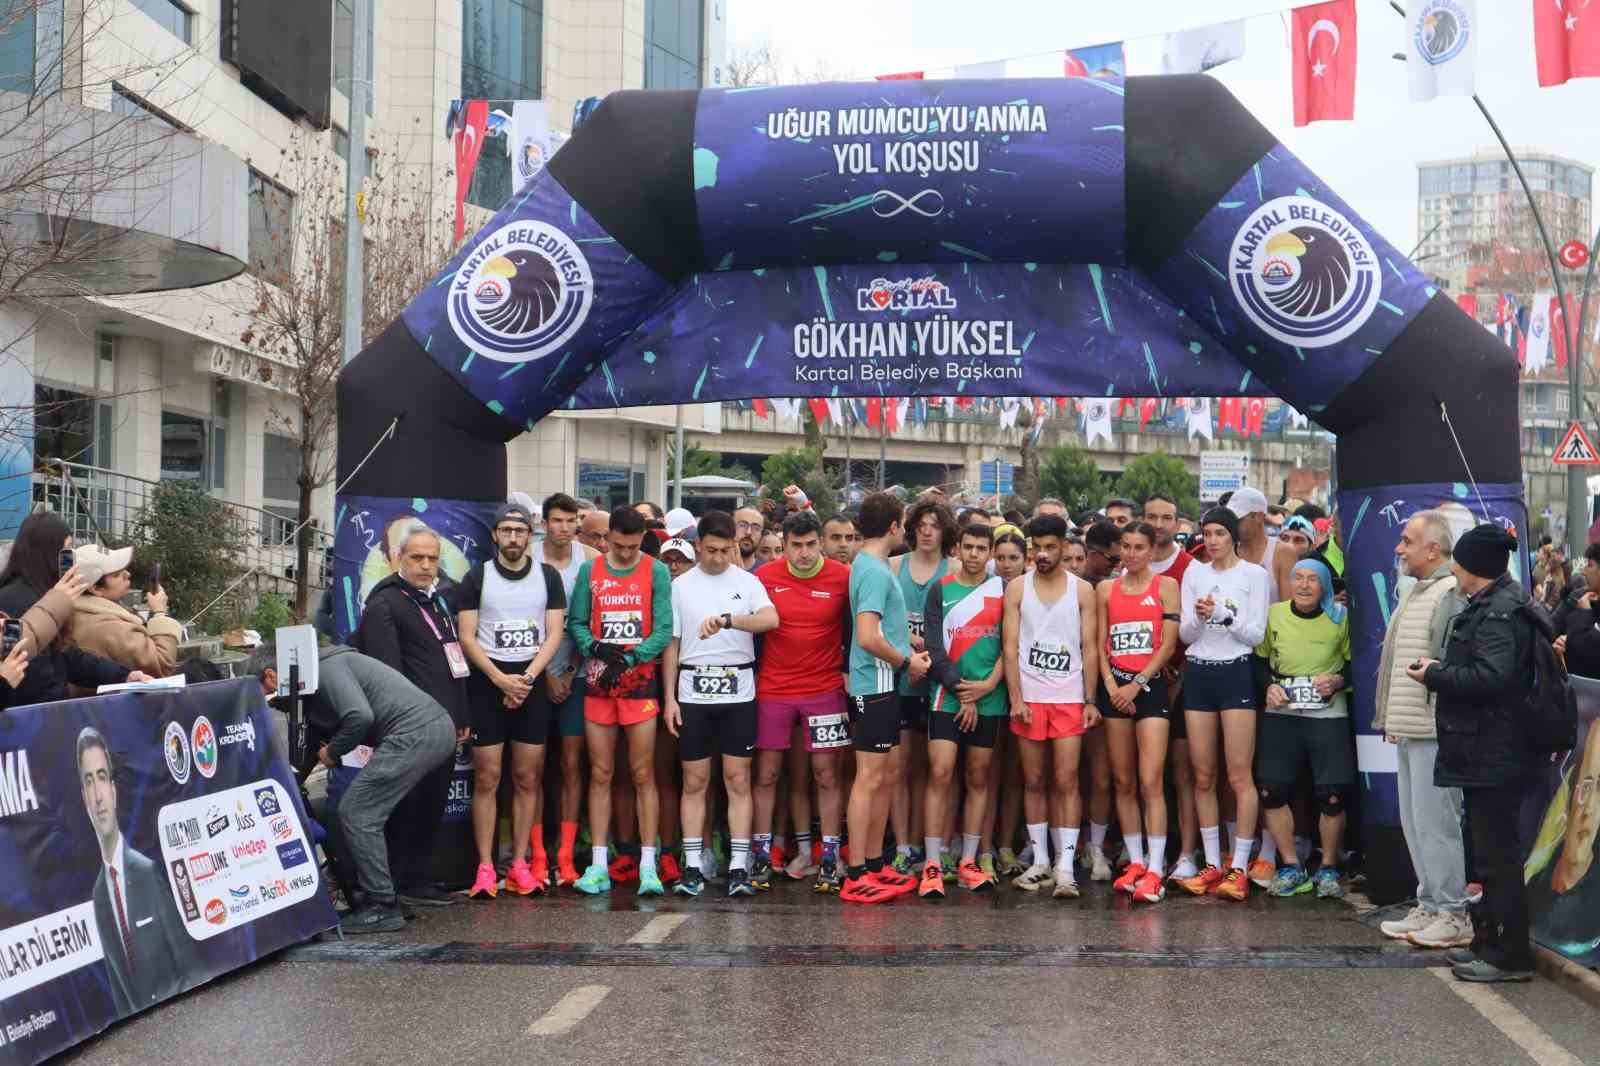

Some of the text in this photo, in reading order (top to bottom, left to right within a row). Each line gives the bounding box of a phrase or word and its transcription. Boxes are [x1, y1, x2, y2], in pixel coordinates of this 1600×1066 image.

[767, 105, 1047, 139] UĞUR MUMCU'YU ANMA
[832, 140, 979, 178] YOL KOŞUSU
[1235, 204, 1374, 271] KARTAL BELEDİYESİ
[455, 228, 588, 291] KARTAL BELEDİYESİ
[793, 314, 1022, 358] GÖKHAN YÜKSEL
[795, 362, 1023, 383] Kartal Belediye Başkanı
[599, 592, 641, 606] TÜRKİYE
[502, 630, 535, 647] 998
[603, 622, 636, 639] 790
[1111, 633, 1150, 650] 1547
[1031, 650, 1070, 670] 1407
[1111, 667, 1133, 682] NIKE
[698, 677, 732, 694] 992
[815, 725, 848, 742] 864
[27, 915, 92, 968] DİLERİM
